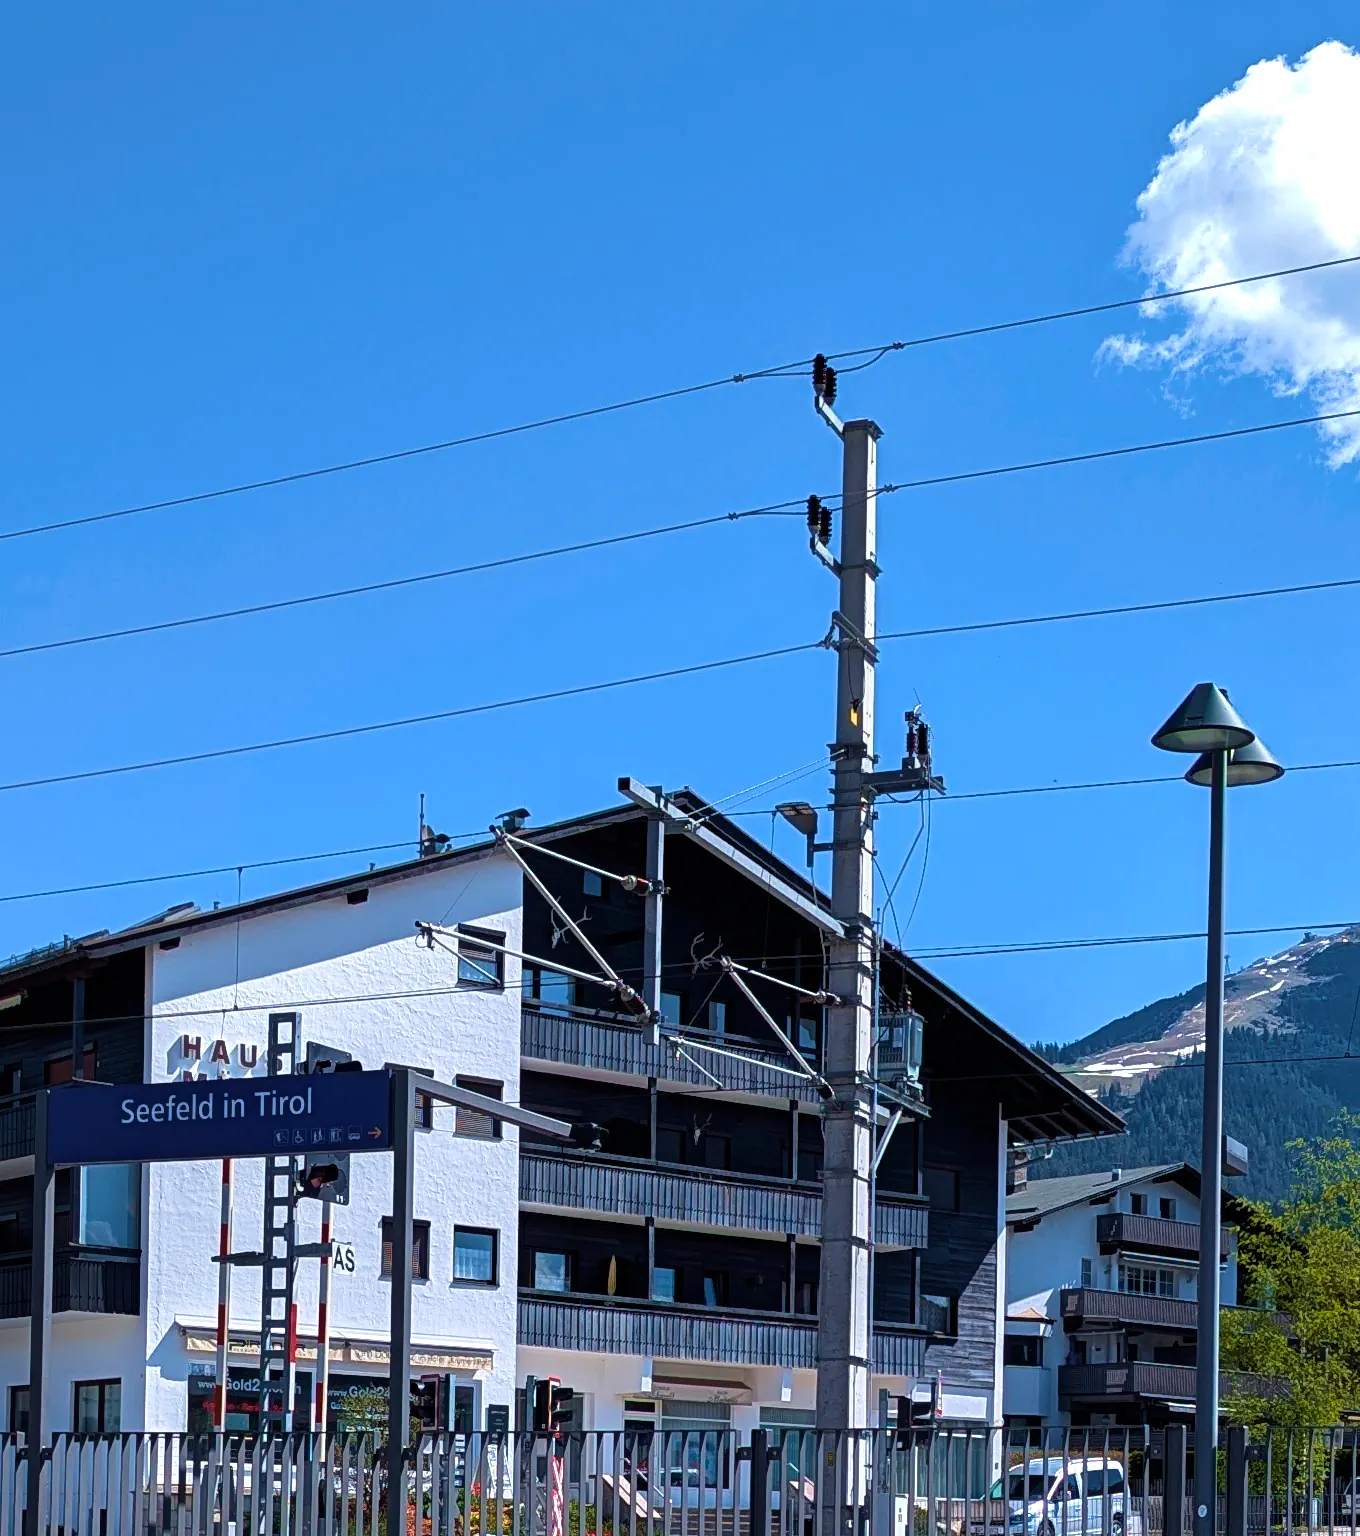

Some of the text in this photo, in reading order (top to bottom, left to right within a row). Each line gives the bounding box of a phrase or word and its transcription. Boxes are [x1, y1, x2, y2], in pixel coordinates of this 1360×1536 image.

[120, 1087, 313, 1124] Seefeld in Tirol
[333, 1245, 355, 1273] AS
